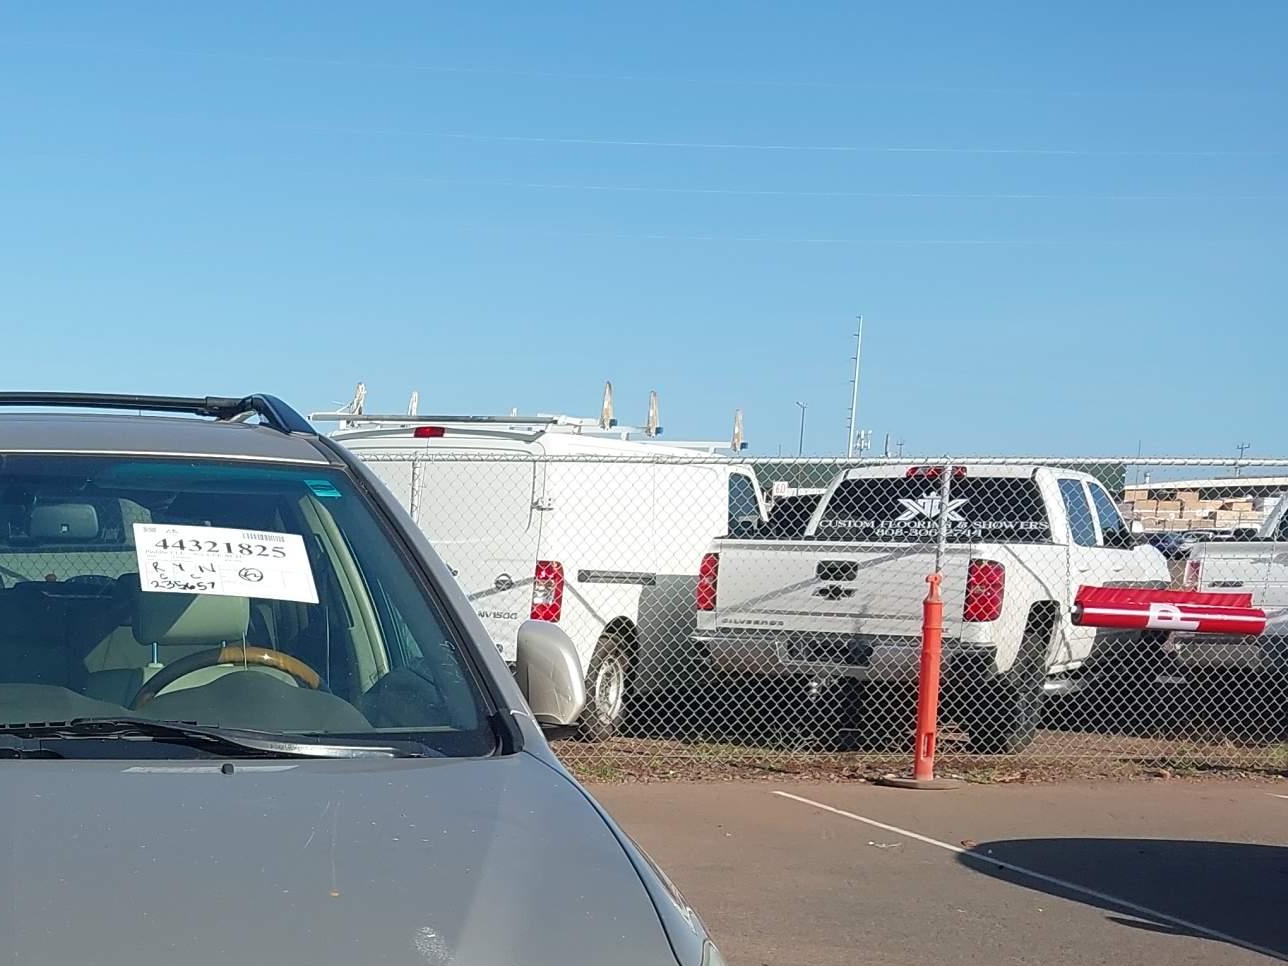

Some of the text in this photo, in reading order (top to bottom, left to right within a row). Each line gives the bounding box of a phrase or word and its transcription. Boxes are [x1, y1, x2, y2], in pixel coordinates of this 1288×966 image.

[819, 520, 875, 529] CUSTOM
[973, 521, 1049, 530] SHOWERS
[155, 538, 287, 559] 44321825
